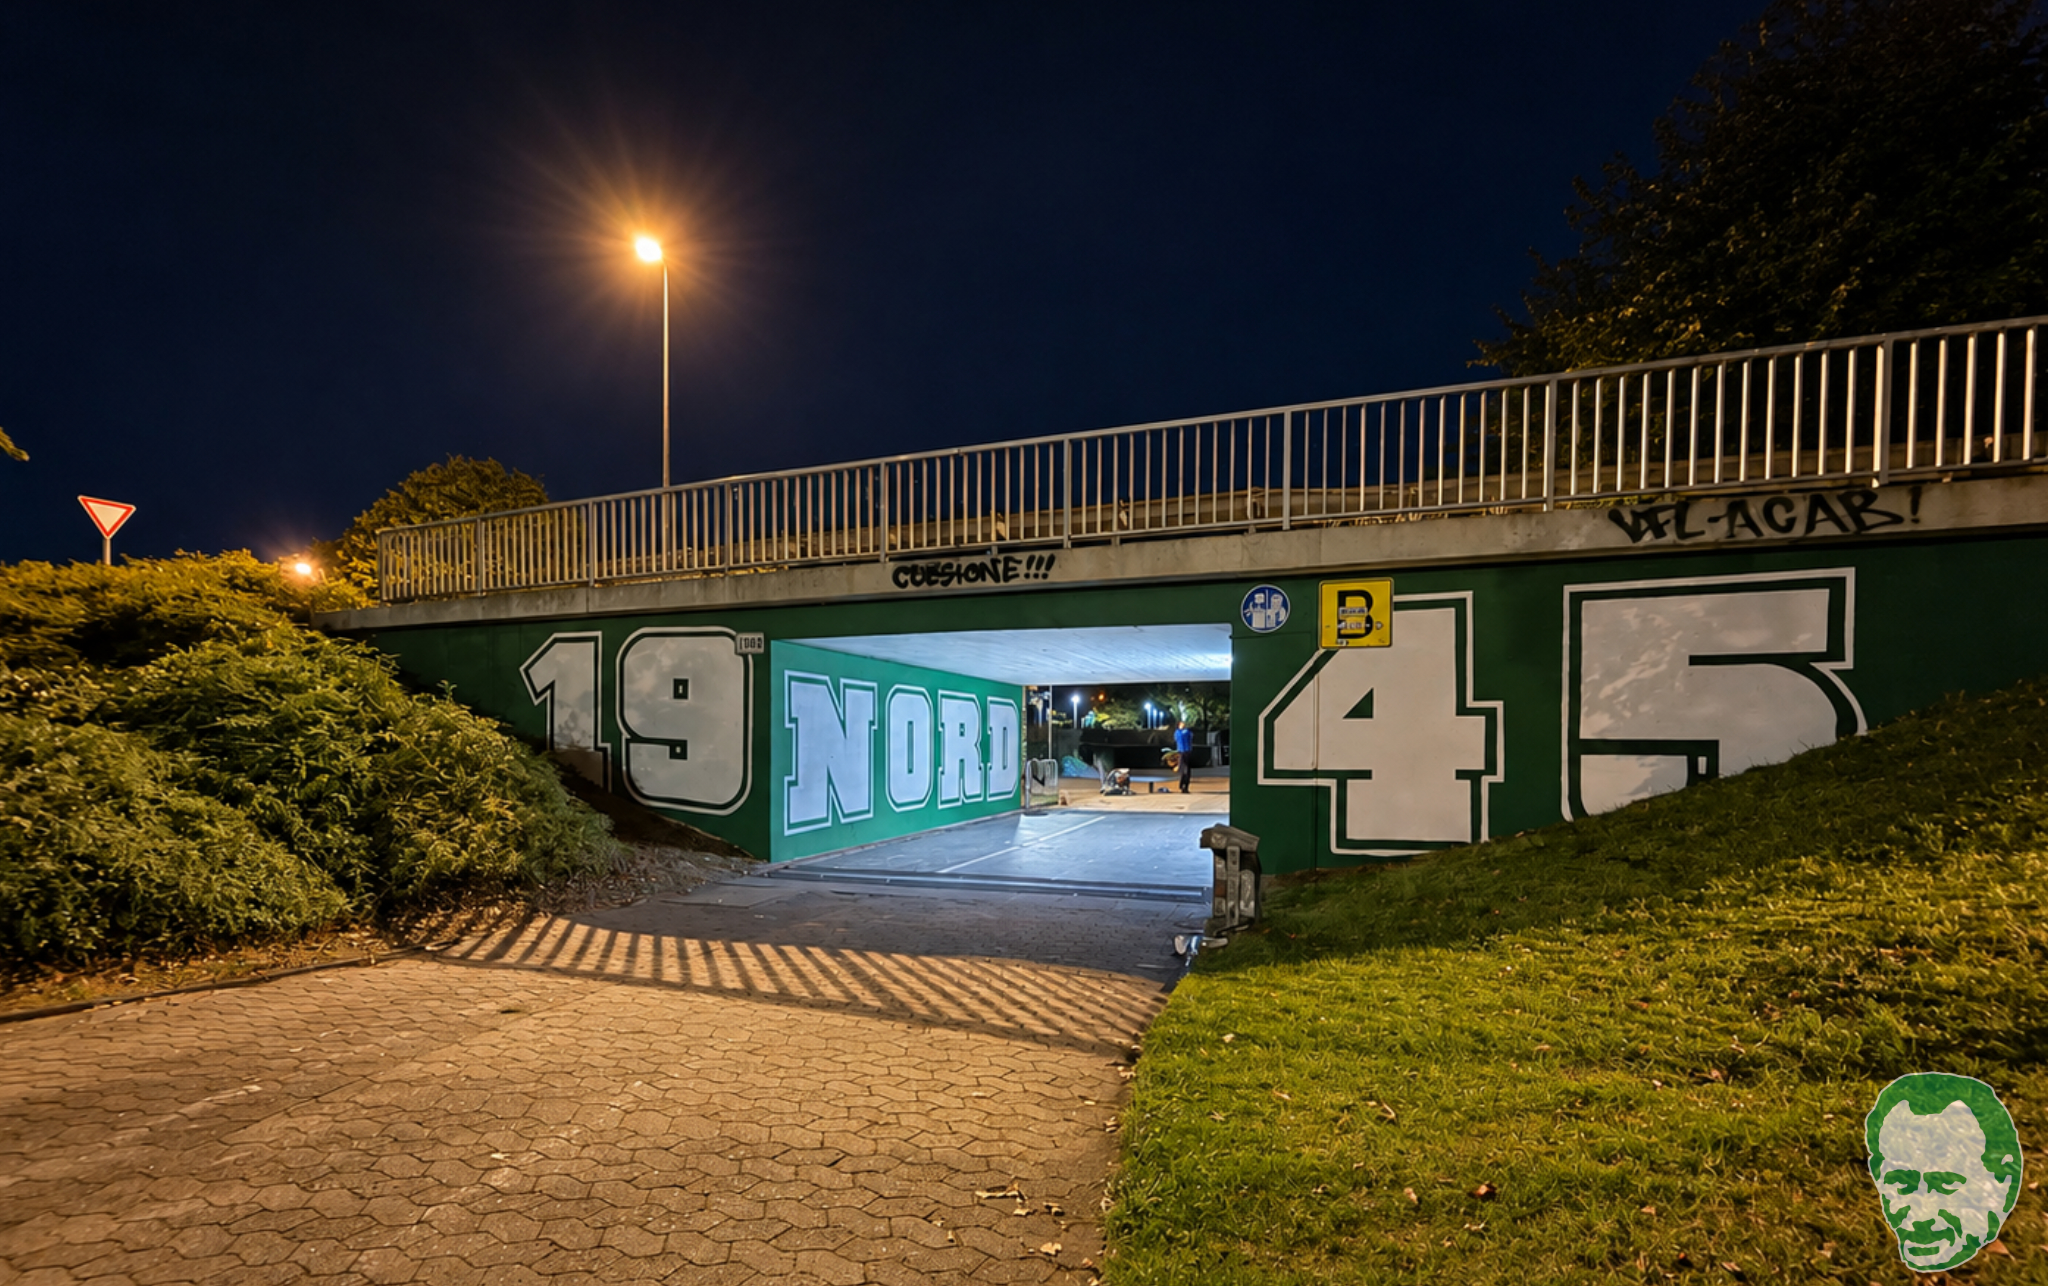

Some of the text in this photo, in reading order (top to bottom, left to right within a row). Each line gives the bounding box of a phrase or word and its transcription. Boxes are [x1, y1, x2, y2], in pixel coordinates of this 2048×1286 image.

[519, 626, 753, 816] 19
[784, 669, 1019, 836] NORD
[1257, 567, 1867, 856] 45
